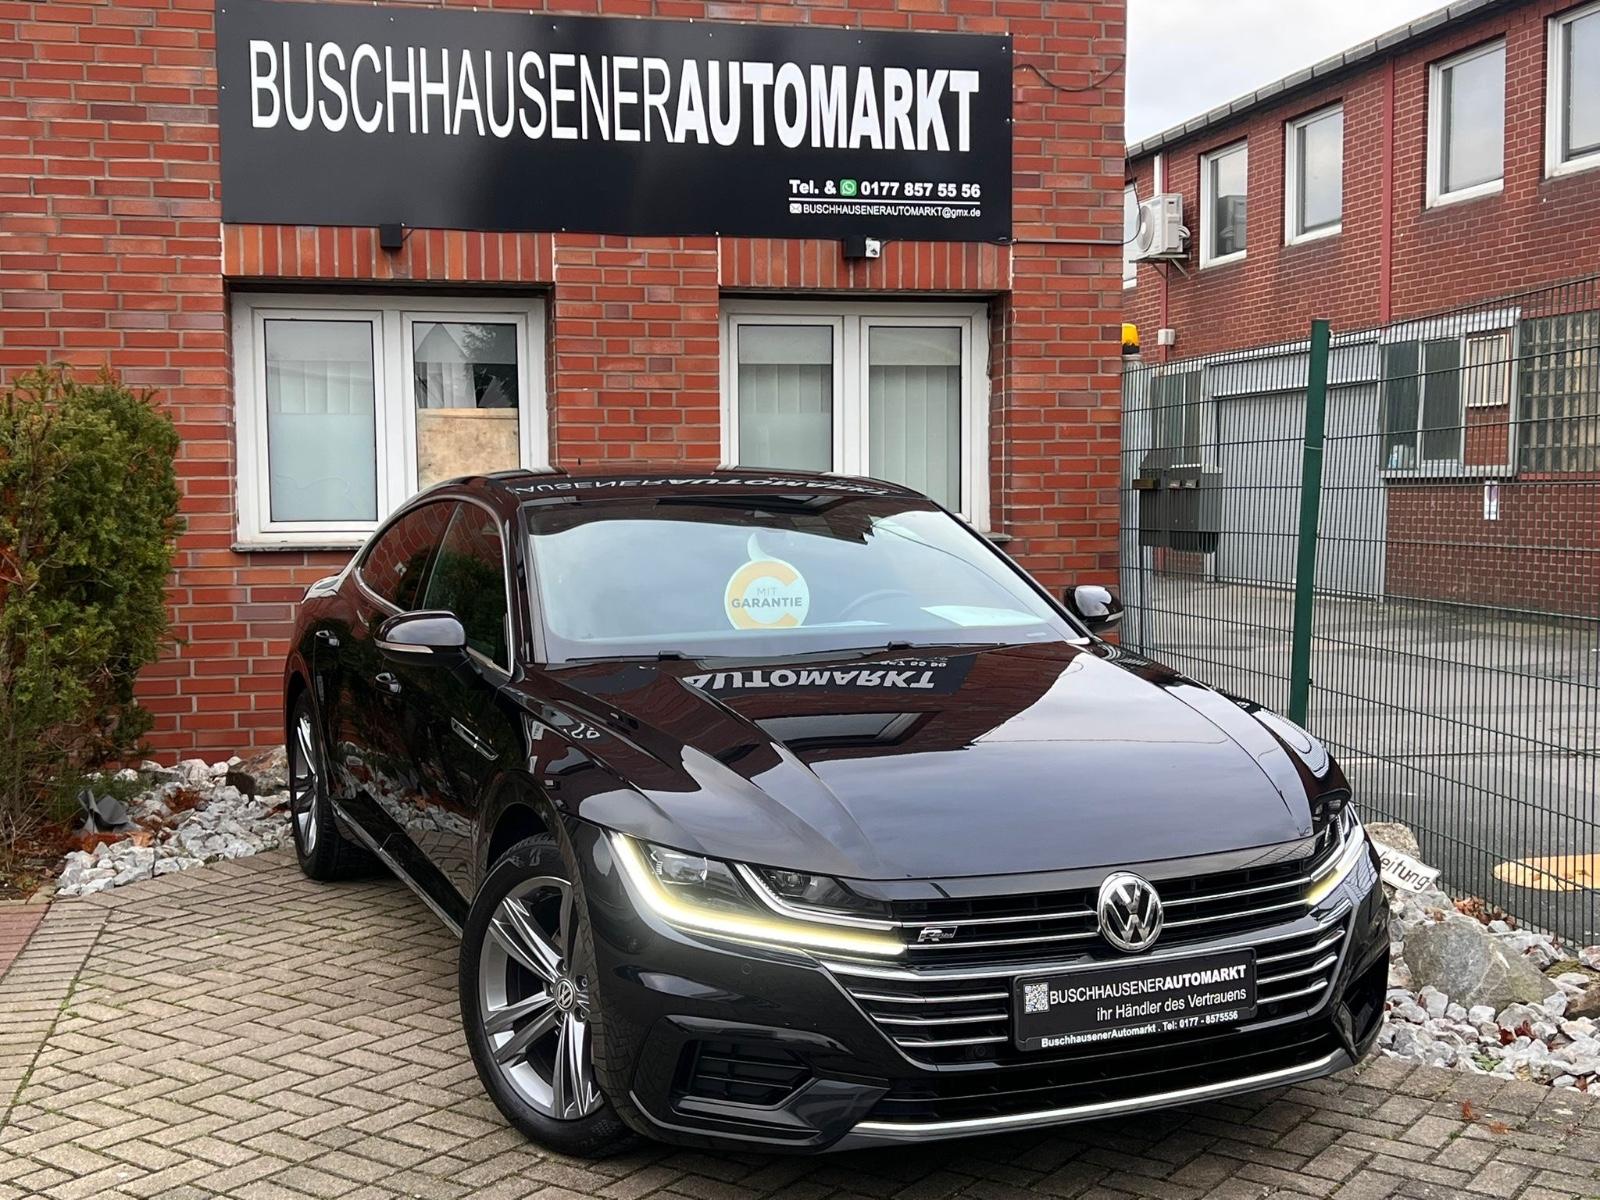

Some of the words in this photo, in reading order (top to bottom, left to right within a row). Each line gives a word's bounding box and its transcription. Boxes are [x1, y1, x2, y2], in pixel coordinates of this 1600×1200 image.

[789, 180, 819, 195] Tel.
[823, 181, 837, 195] &
[860, 181, 900, 196] 0177
[903, 183, 934, 198] 857
[937, 183, 957, 198] 55
[961, 184, 981, 198] 56
[803, 203, 981, 218] BUSCHHAUSENERAUTOMARKT@gmx.de
[756, 587, 776, 597] MIT
[731, 597, 803, 609] GARANTIE
[1050, 965, 1247, 1004] BUSCHHAUSENERAUTOMARKT
[1096, 1007, 1111, 1021] ihr
[1116, 1001, 1162, 1019] Händler
[1164, 998, 1185, 1012] des
[1188, 988, 1247, 1007] Vertrauens
[1041, 1023, 1157, 1048] BuschhausenerAutomarkt
[1162, 1021, 1177, 1031] Tel:
[1179, 1017, 1199, 1028] 0177
[1205, 1011, 1239, 1025] 8575556
